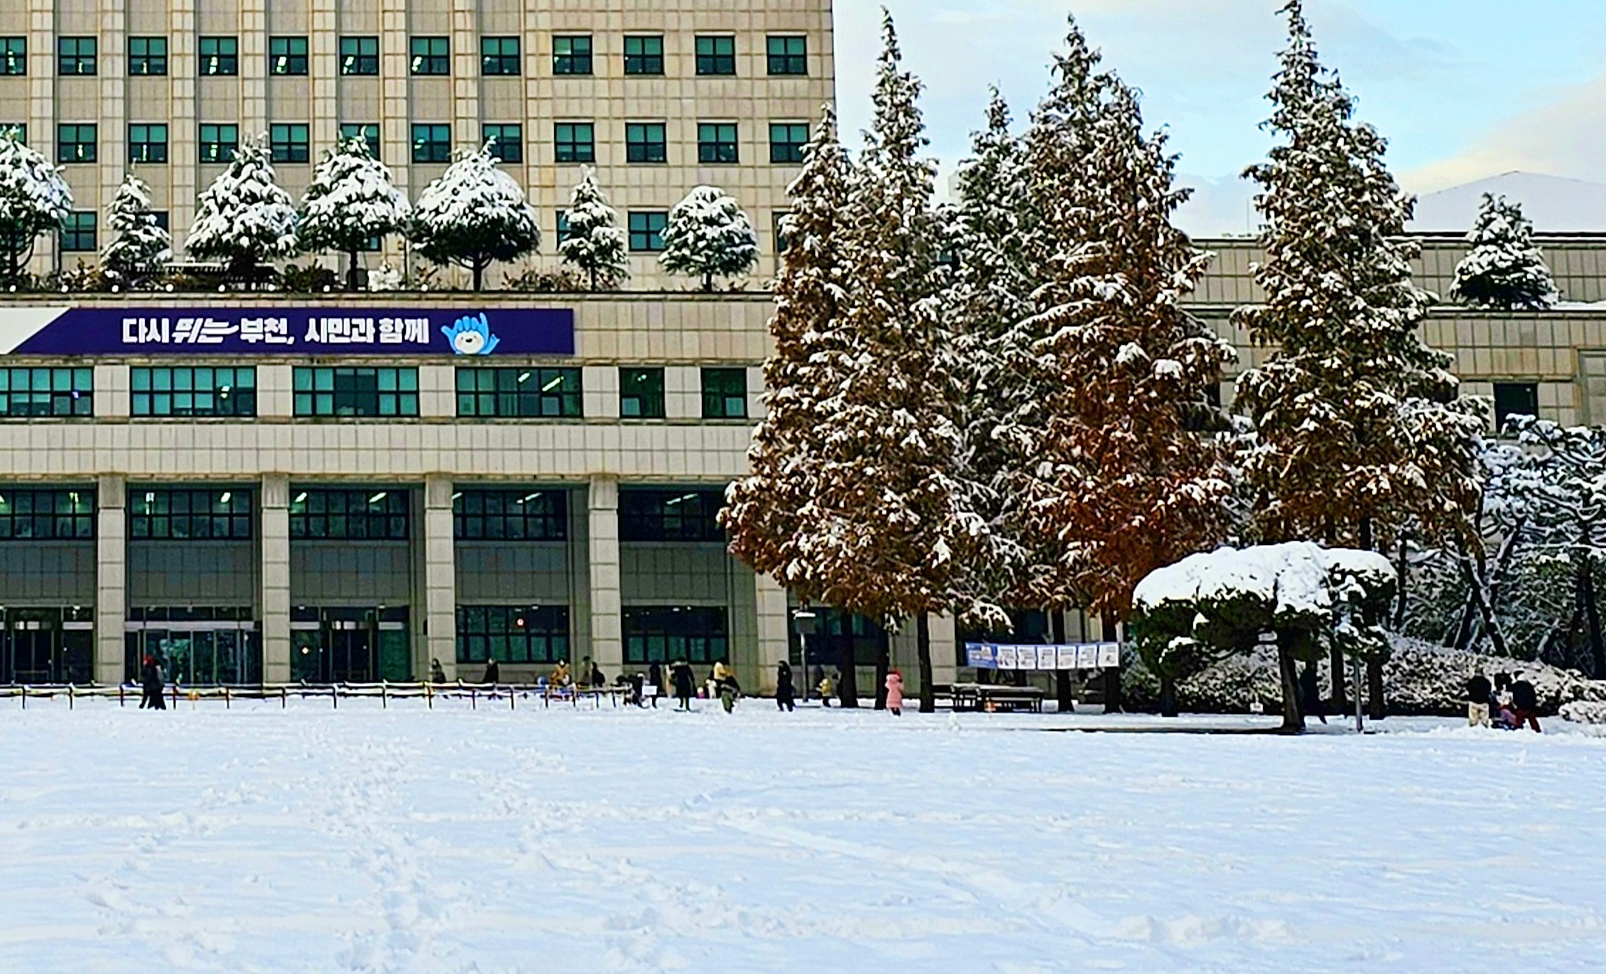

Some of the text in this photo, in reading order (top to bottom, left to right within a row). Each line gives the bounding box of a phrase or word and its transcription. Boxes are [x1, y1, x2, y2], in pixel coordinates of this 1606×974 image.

[122, 317, 430, 345] 다시 뛰는 부천, 시민과 함께
